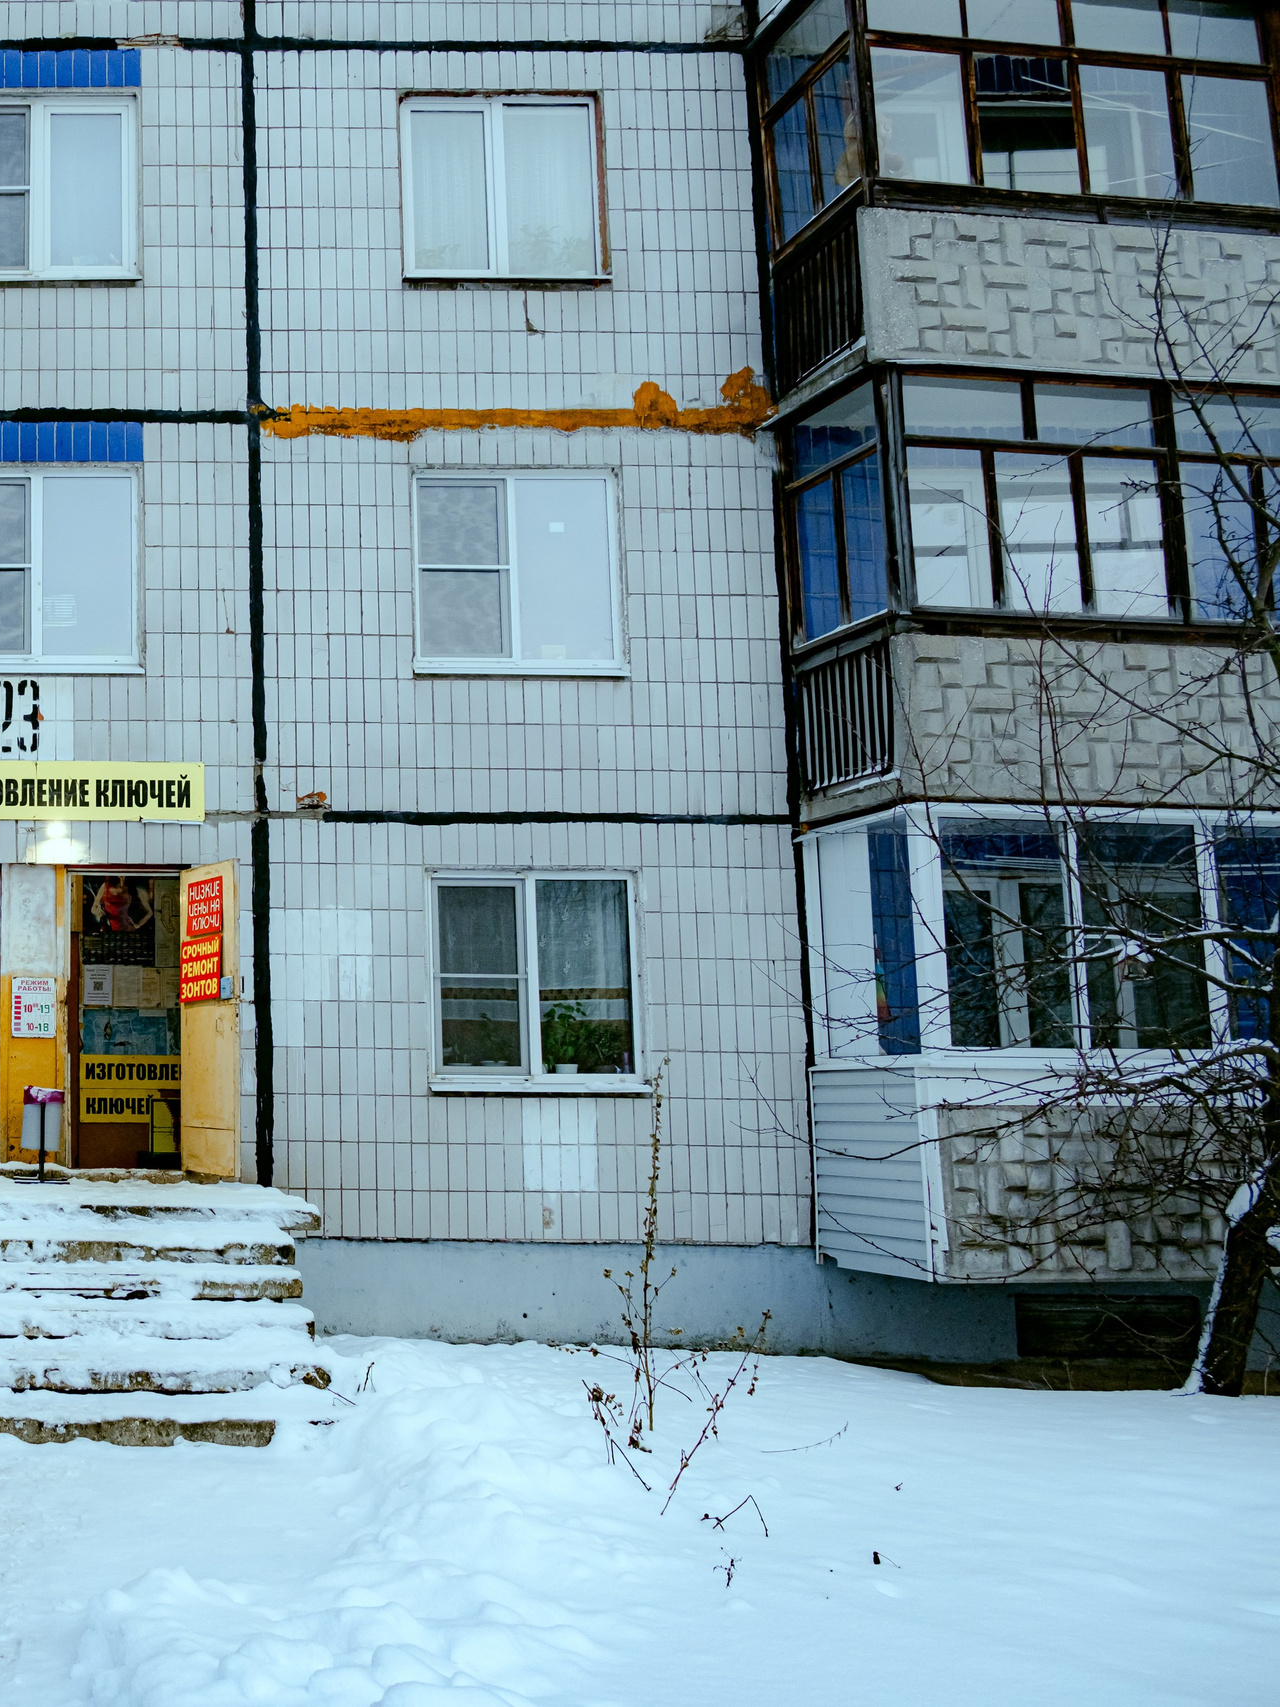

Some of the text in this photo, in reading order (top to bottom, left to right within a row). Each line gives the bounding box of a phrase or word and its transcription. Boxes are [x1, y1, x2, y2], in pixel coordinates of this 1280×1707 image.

[95, 774, 191, 808] КЛЮЧЕЙ
[189, 881, 220, 901] НИЗКИЕ
[188, 898, 220, 917] ЦЕНЫ НА
[192, 914, 220, 931] КЛЮЧИ
[182, 937, 219, 959] СРОЧНЫЙ
[182, 957, 219, 978] РЕМОНТ
[181, 978, 218, 999] ЗОНТОВ
[85, 1063, 181, 1081] ИЗГОТОВЛЕ
